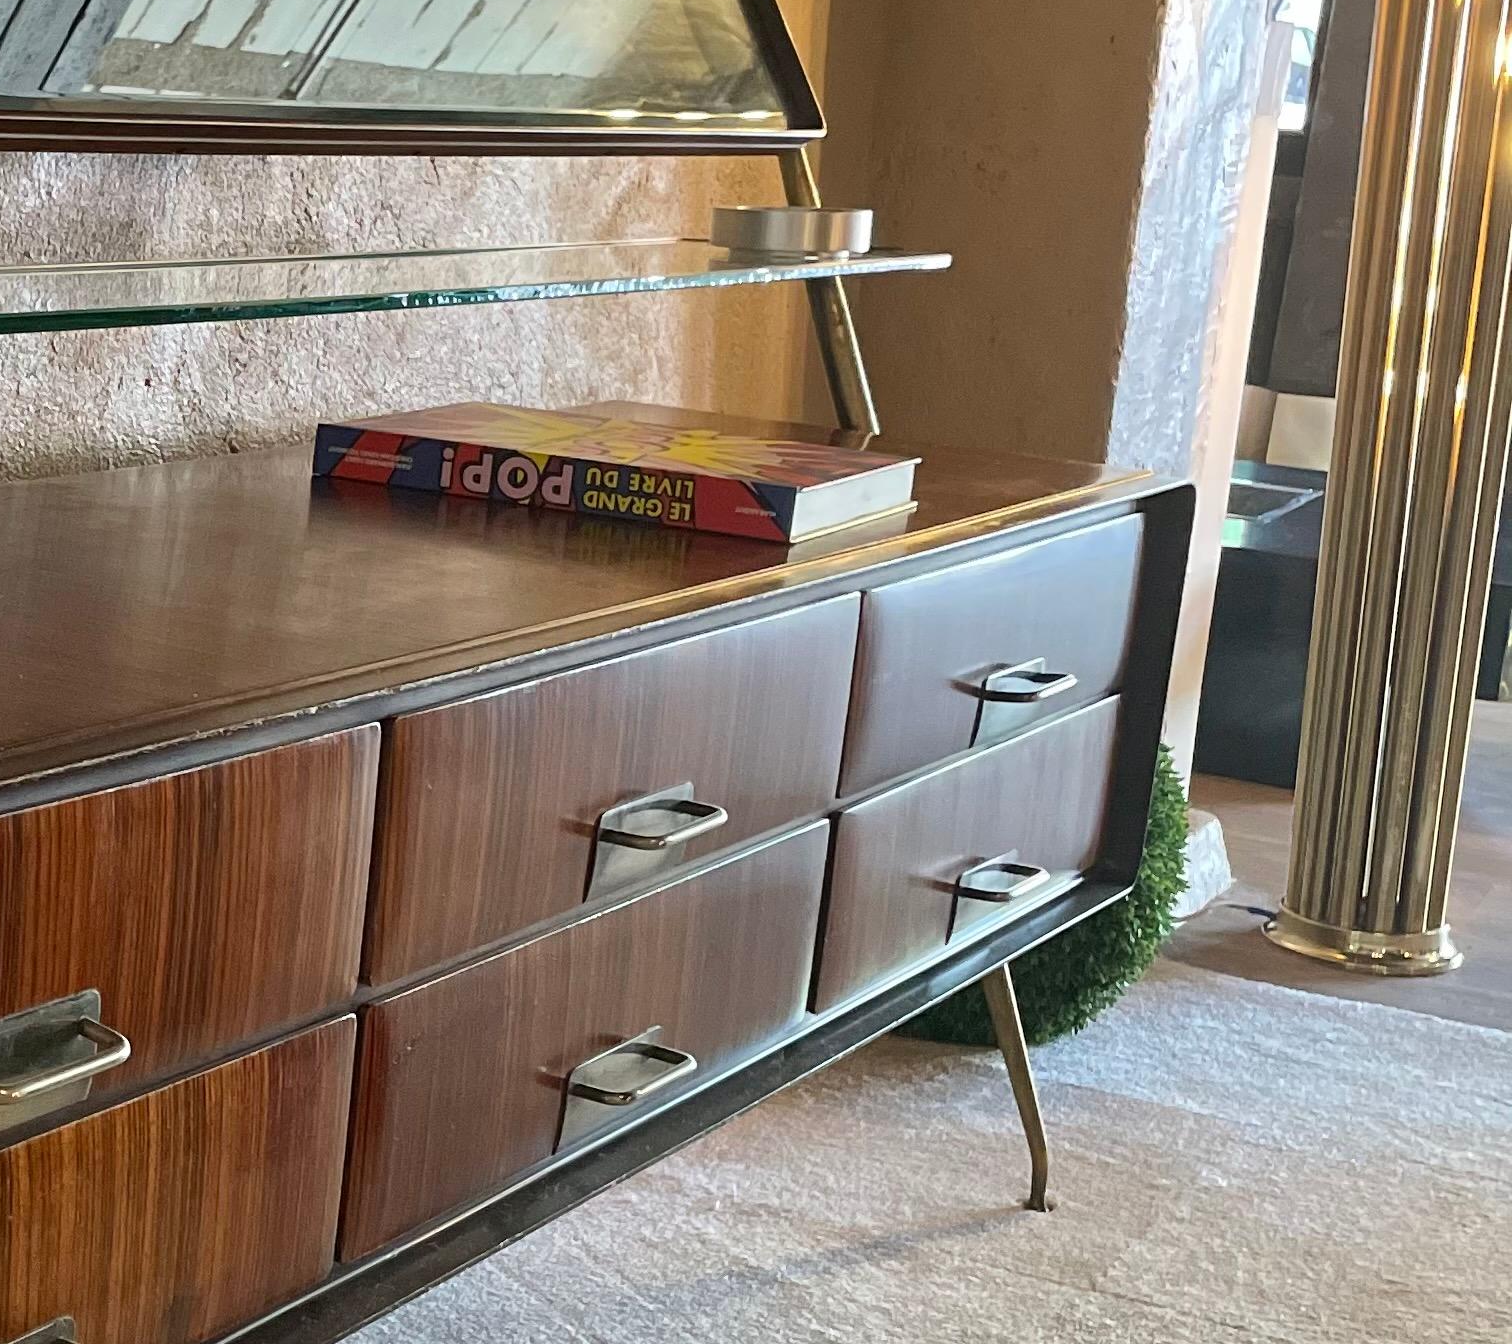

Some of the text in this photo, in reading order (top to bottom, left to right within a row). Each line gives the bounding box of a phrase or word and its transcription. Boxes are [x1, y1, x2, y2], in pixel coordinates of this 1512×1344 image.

[441, 448, 574, 506] POP!
[585, 466, 695, 499] LIVRE DU
[582, 491, 692, 522] LE GRAND
